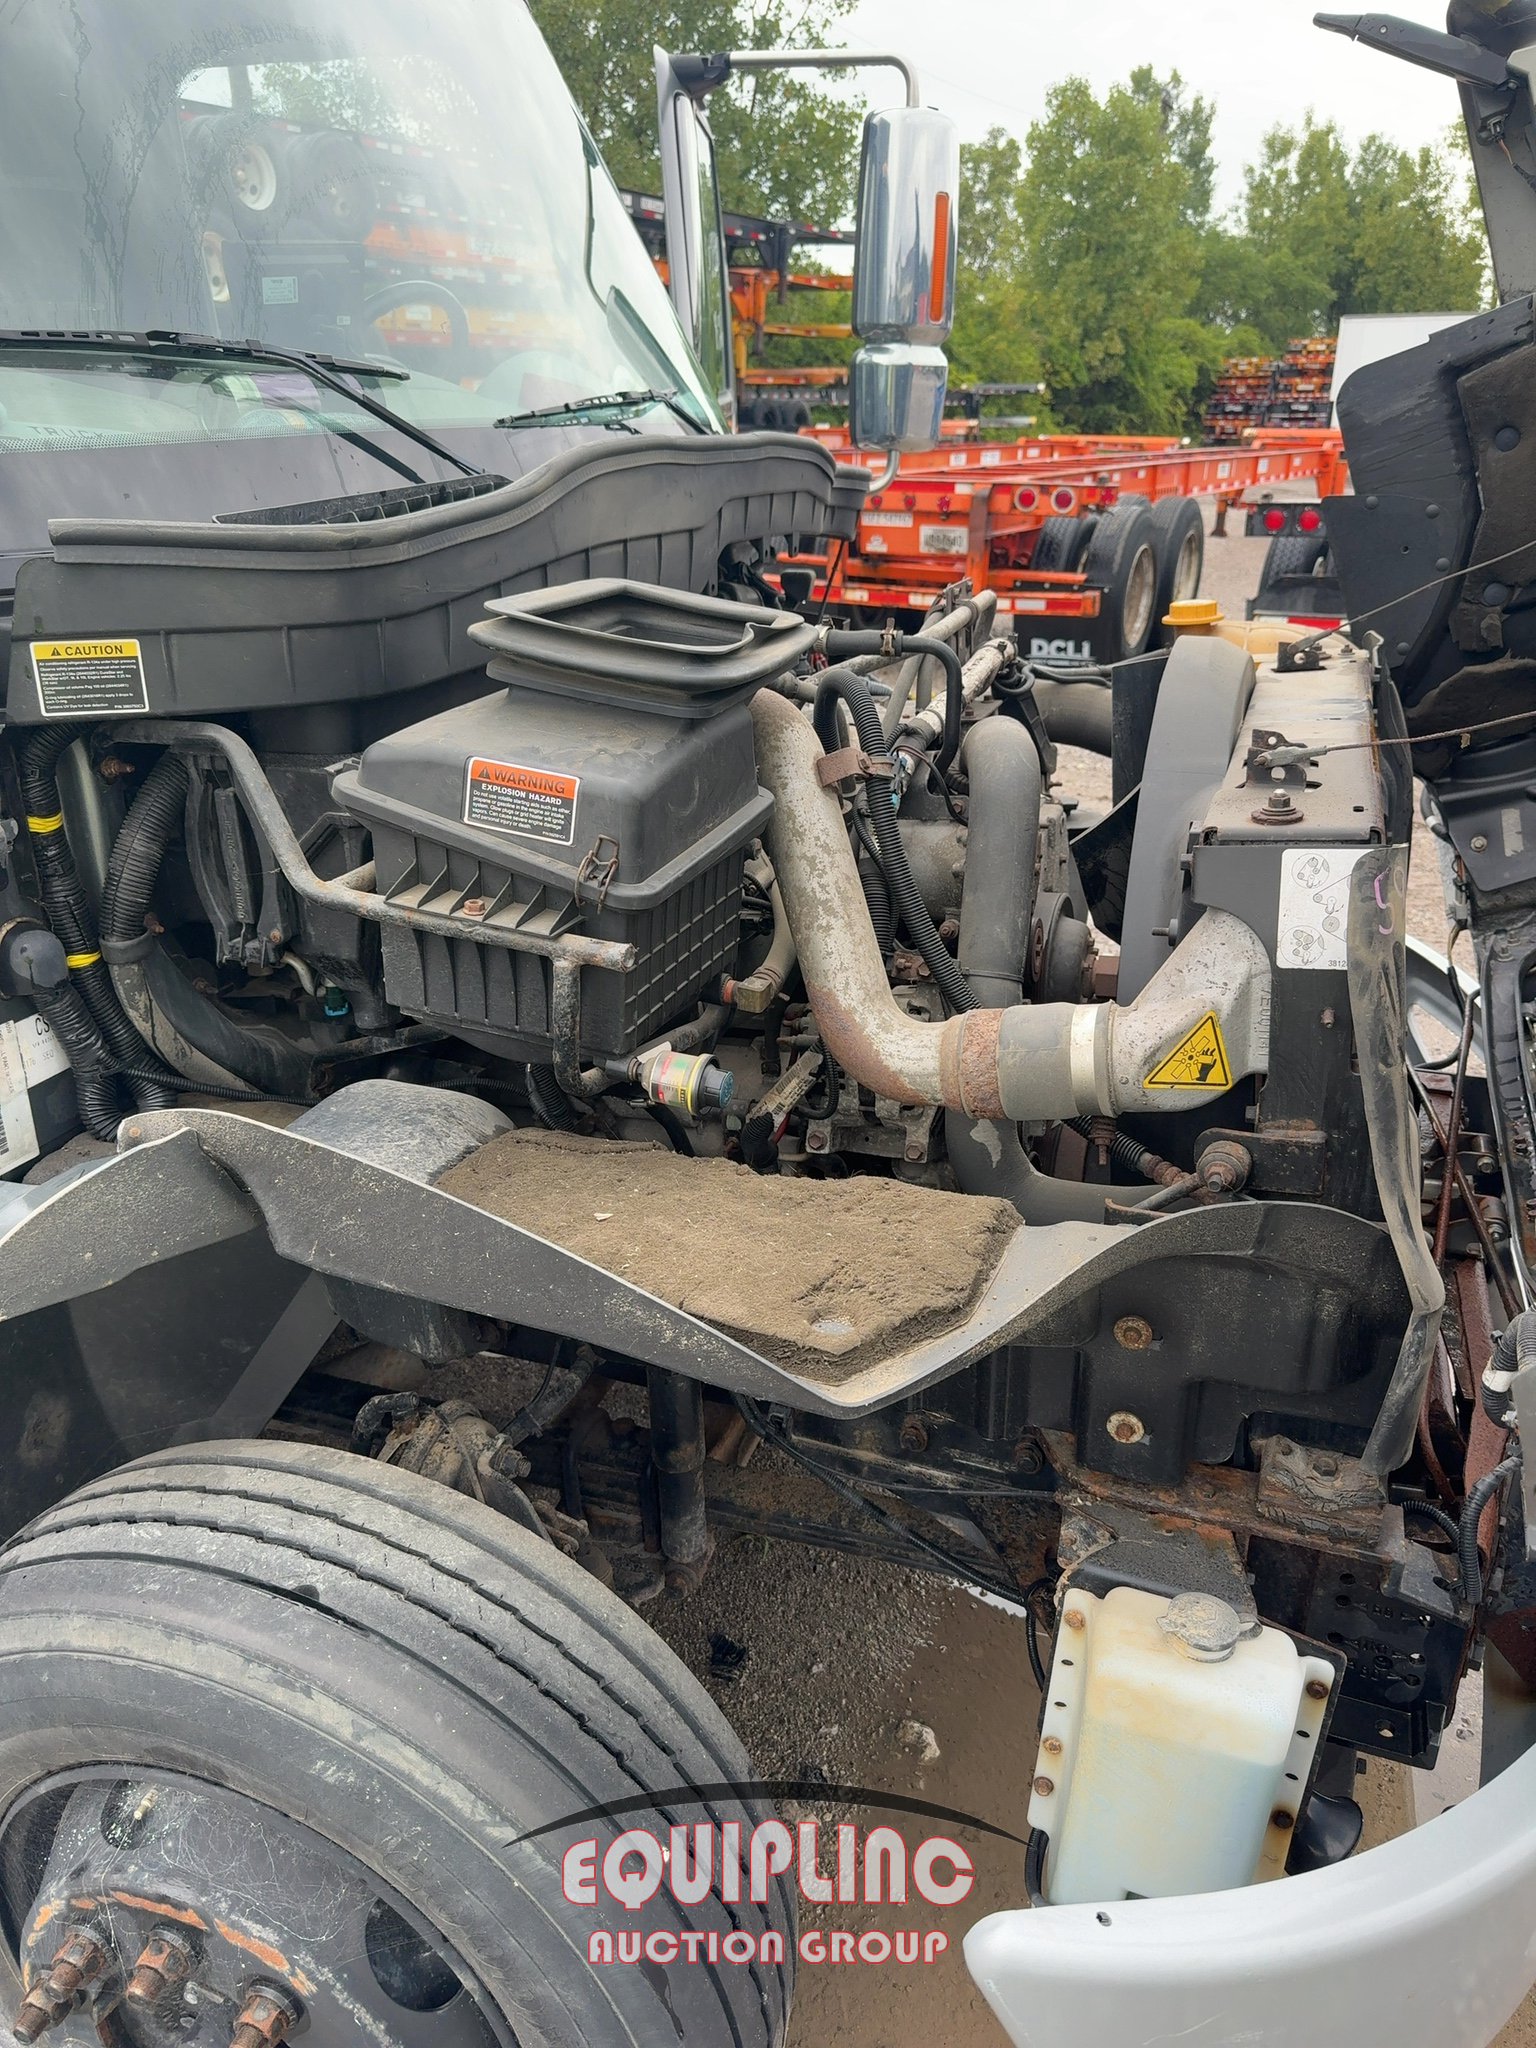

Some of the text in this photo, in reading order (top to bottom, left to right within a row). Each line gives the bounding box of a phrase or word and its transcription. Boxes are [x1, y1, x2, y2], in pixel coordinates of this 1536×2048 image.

[65, 645, 124, 656] CAUTION
[1031, 638, 1091, 658] DCLI
[494, 768, 565, 794] WARNING
[482, 783, 562, 805] EXPLOSION HAZARD
[544, 822, 562, 830] damage
[1328, 960, 1347, 968] 3812
